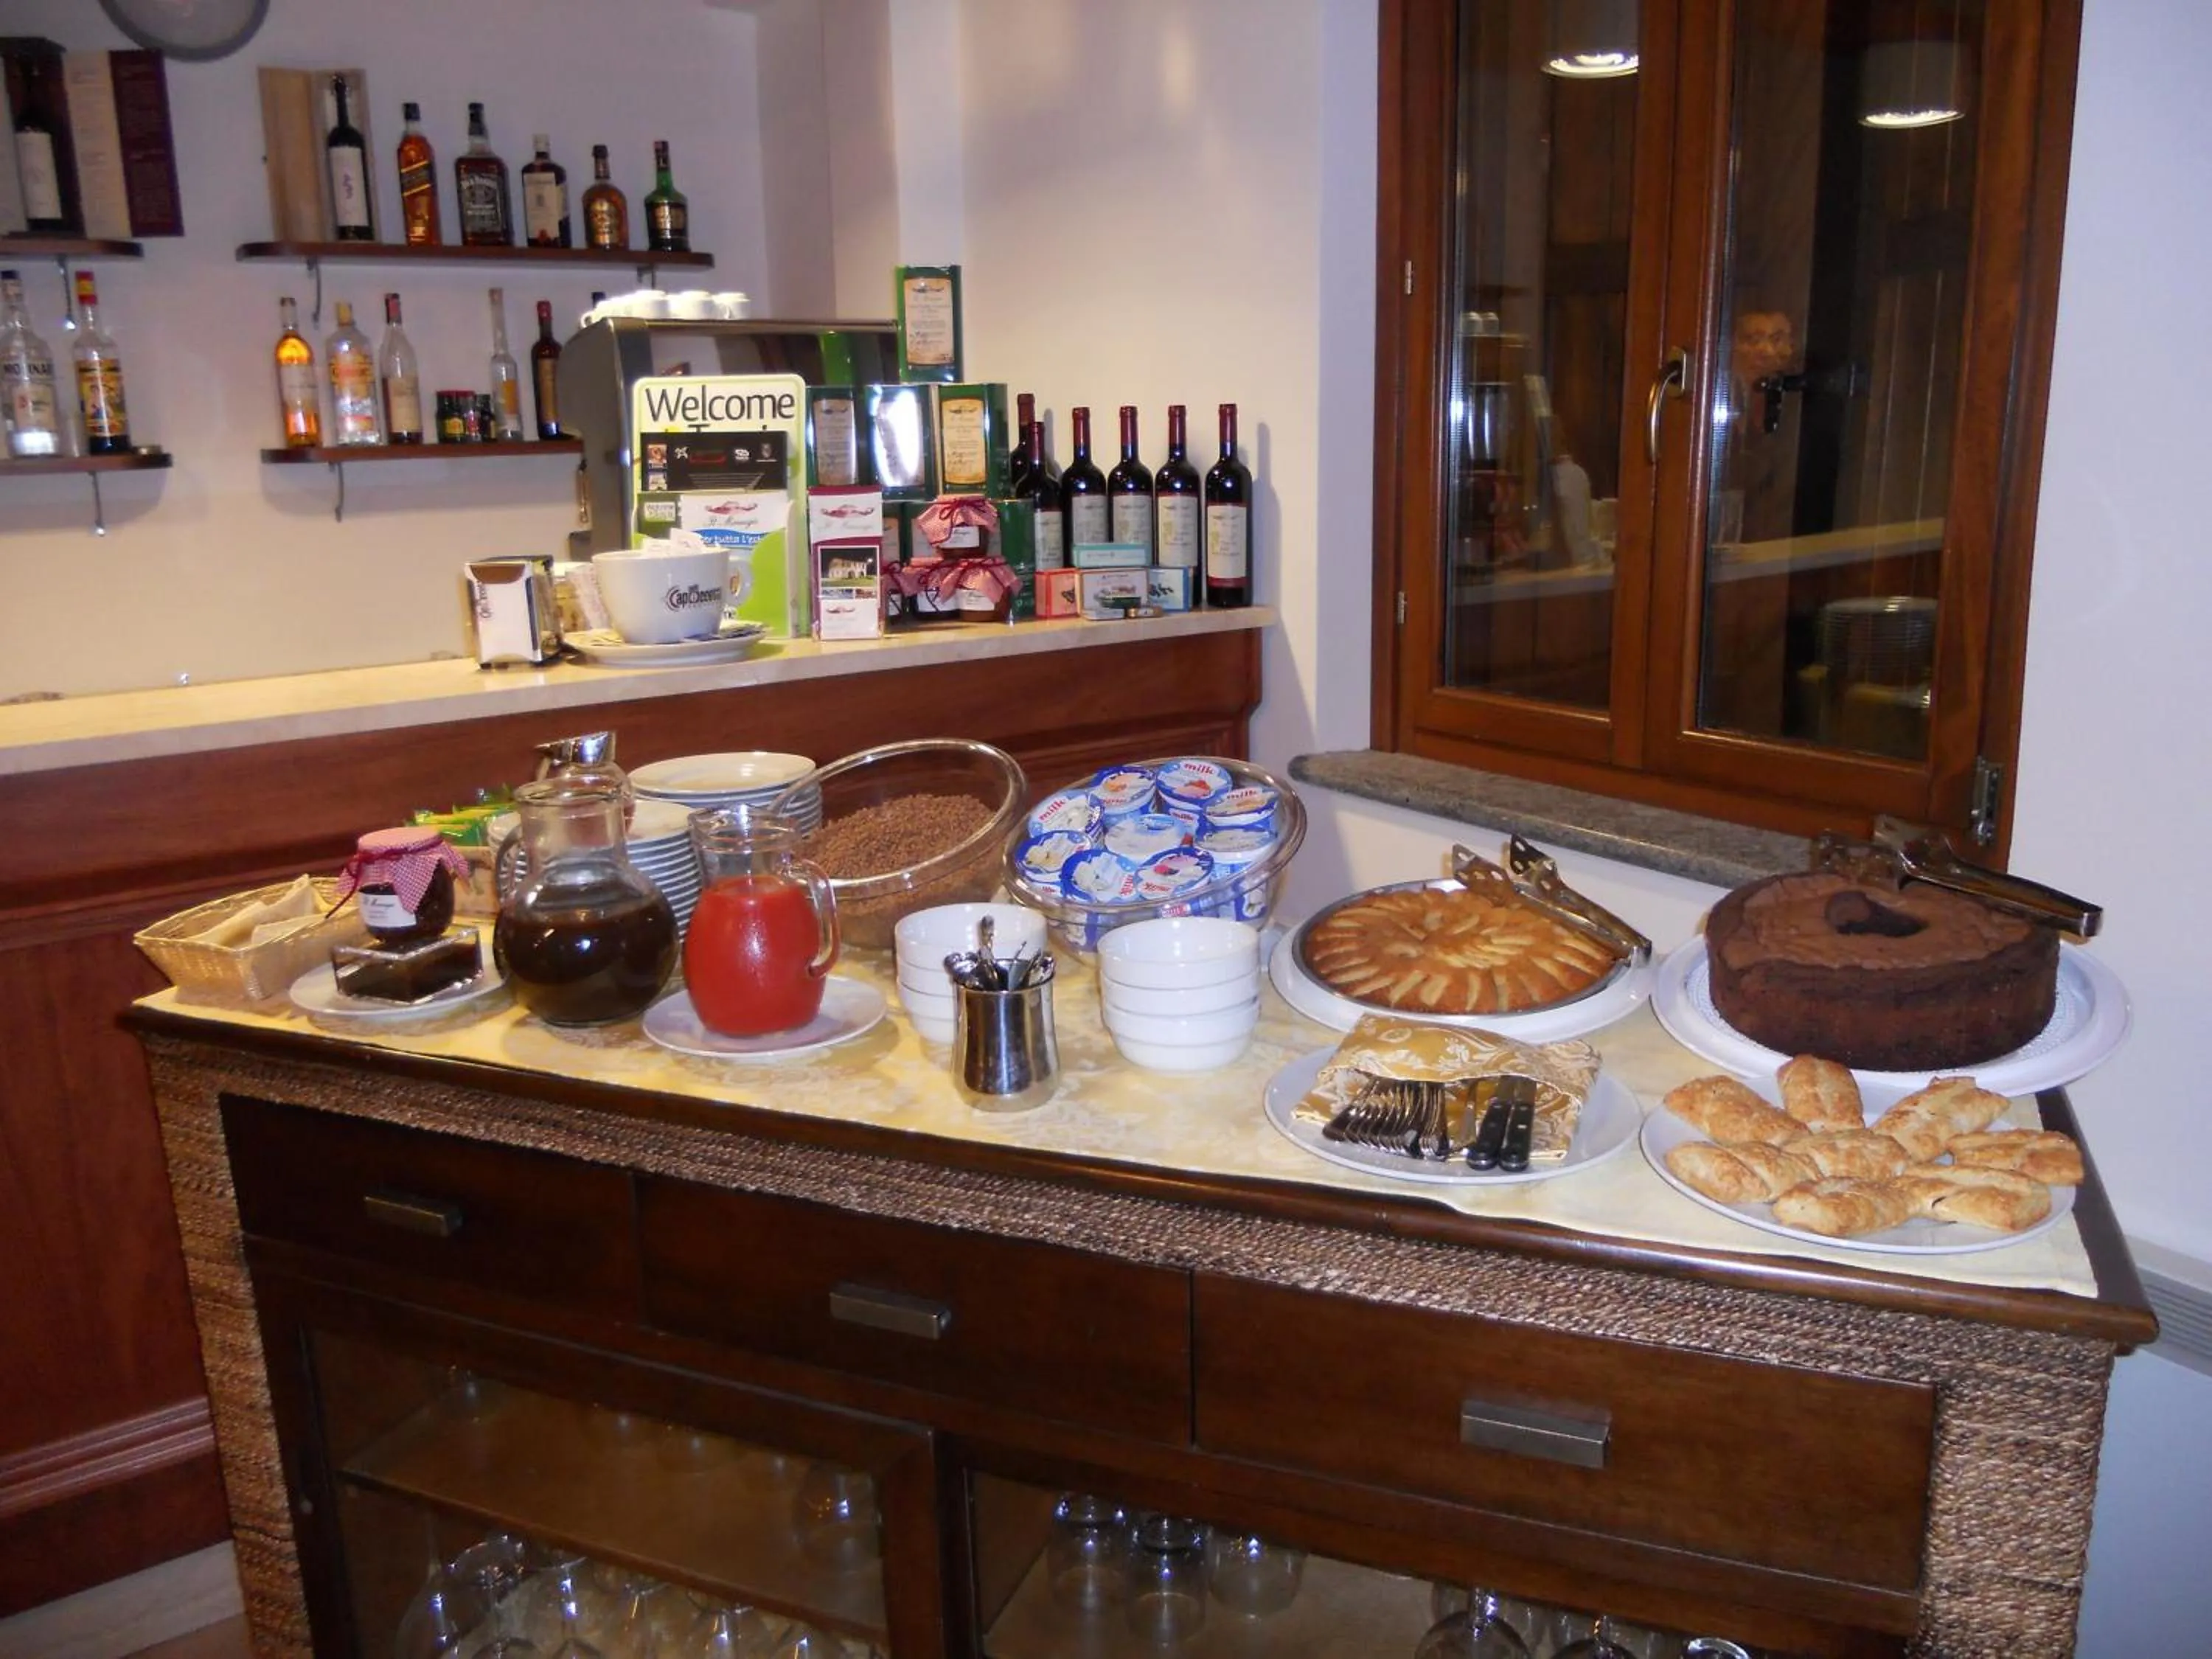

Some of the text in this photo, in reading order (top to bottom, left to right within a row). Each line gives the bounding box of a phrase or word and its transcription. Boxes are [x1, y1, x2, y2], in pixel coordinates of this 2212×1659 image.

[644, 384, 796, 422] Welcome
[1183, 762, 1215, 775] milk
[1037, 798, 1067, 822] milk
